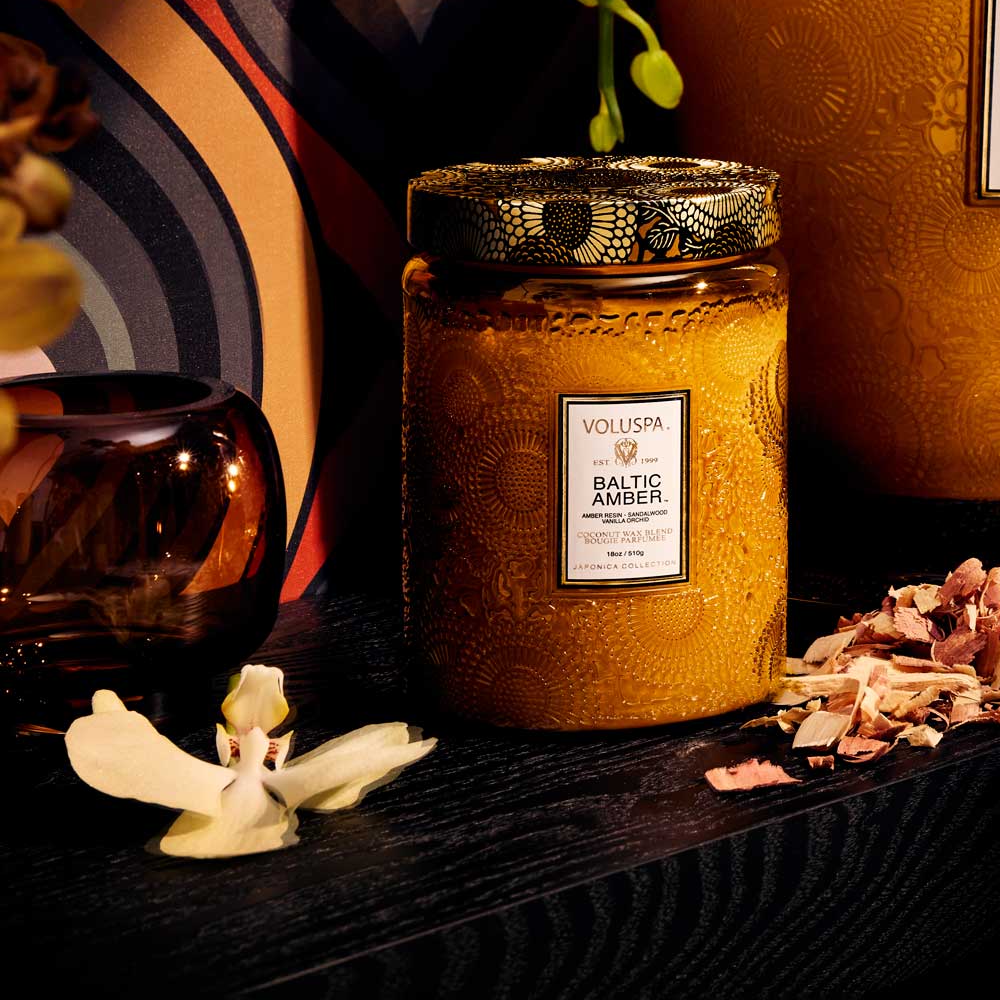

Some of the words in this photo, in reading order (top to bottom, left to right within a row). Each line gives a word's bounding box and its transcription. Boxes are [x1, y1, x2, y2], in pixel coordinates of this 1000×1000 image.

[583, 416, 664, 434] VOLUSPA
[593, 474, 662, 490] BALTIC
[592, 490, 662, 506] AMBER
[627, 510, 668, 518] SANDALWOOD
[577, 531, 620, 539] COCONUT
[645, 528, 673, 536] BLEND
[573, 563, 618, 571] JAPONICA
[621, 560, 676, 570] COLLECTION
